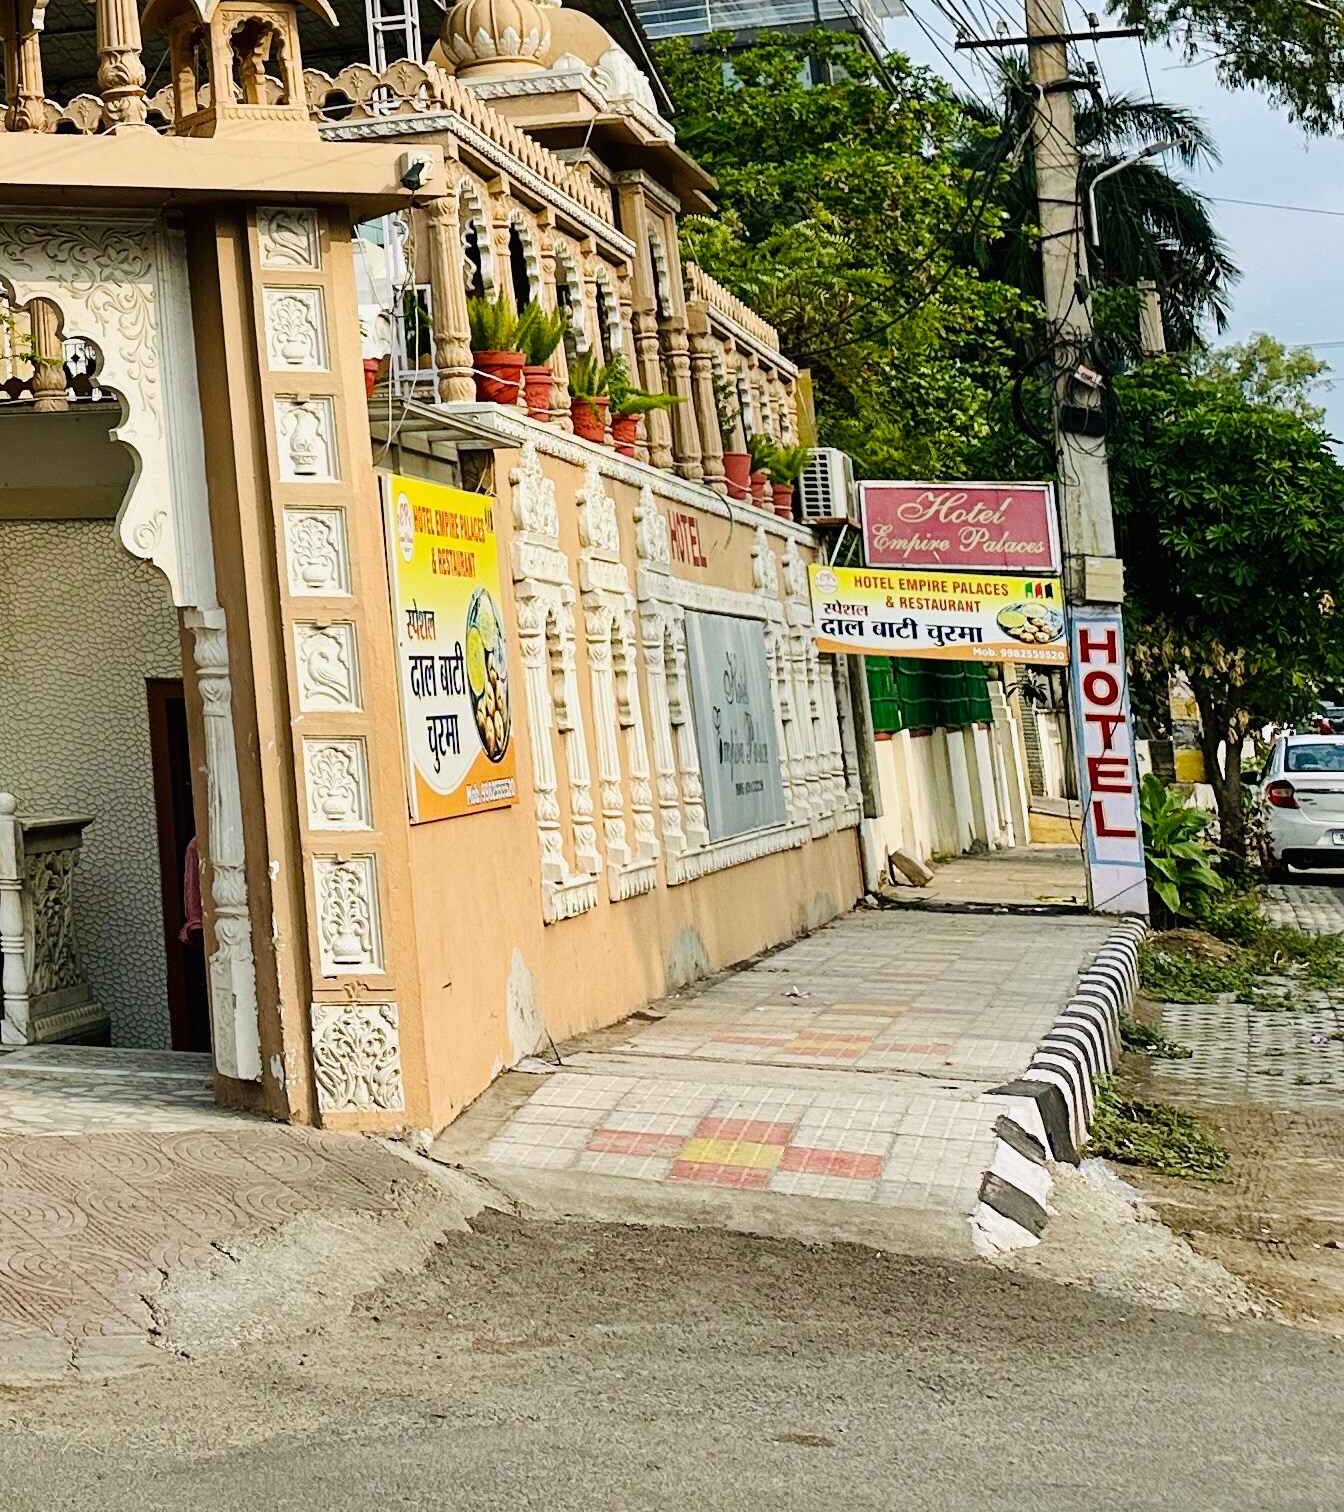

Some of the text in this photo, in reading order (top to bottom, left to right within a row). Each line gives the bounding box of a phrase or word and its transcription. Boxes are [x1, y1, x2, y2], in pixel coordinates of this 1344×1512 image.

[413, 505, 434, 535] HOTEL
[897, 492, 1012, 524] Hotel
[668, 509, 707, 568] HOTEL
[872, 524, 1045, 558] Empire Palaces
[854, 576, 1009, 596] HOTEL EMPIRE PALACES
[406, 598, 436, 640] स्पेशल
[823, 600, 869, 616] स्पेशल
[886, 595, 981, 613] & RESTAURANT
[820, 618, 983, 647] दाल बाटी चुरमा
[973, 647, 998, 657] Mob.
[409, 641, 466, 700] दाल बाटी
[426, 714, 460, 774] चुरमा
[1079, 629, 1136, 838] HOTEL
